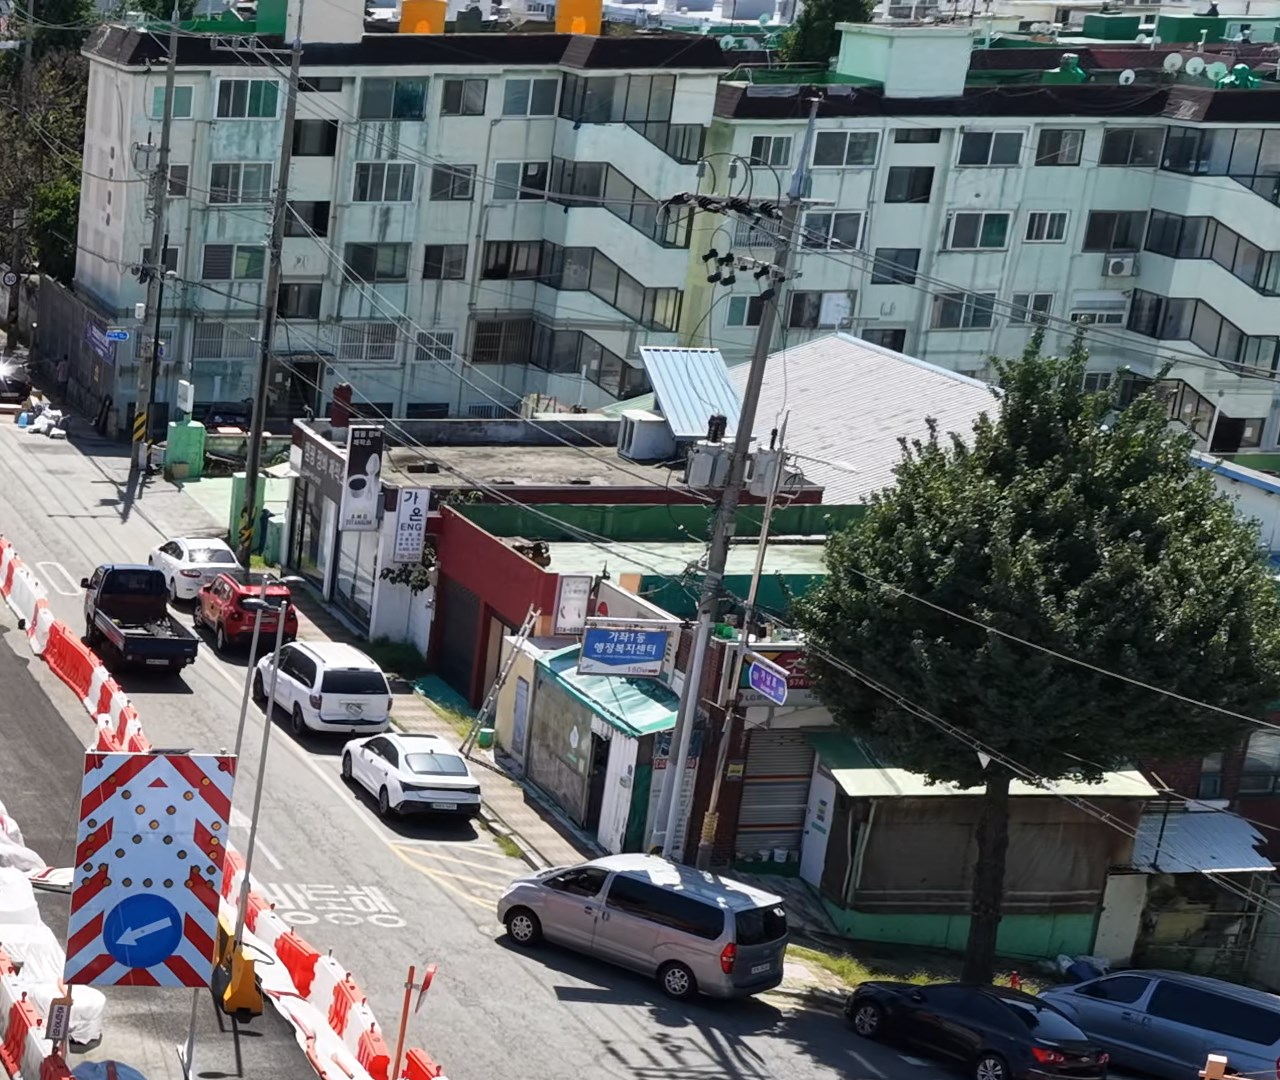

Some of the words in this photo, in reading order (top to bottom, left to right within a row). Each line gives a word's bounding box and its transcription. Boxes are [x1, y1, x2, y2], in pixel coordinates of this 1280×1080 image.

[400, 523, 422, 532] ENG
[608, 631, 646, 643] 가좌1동
[594, 642, 657, 656] 행정복지센터
